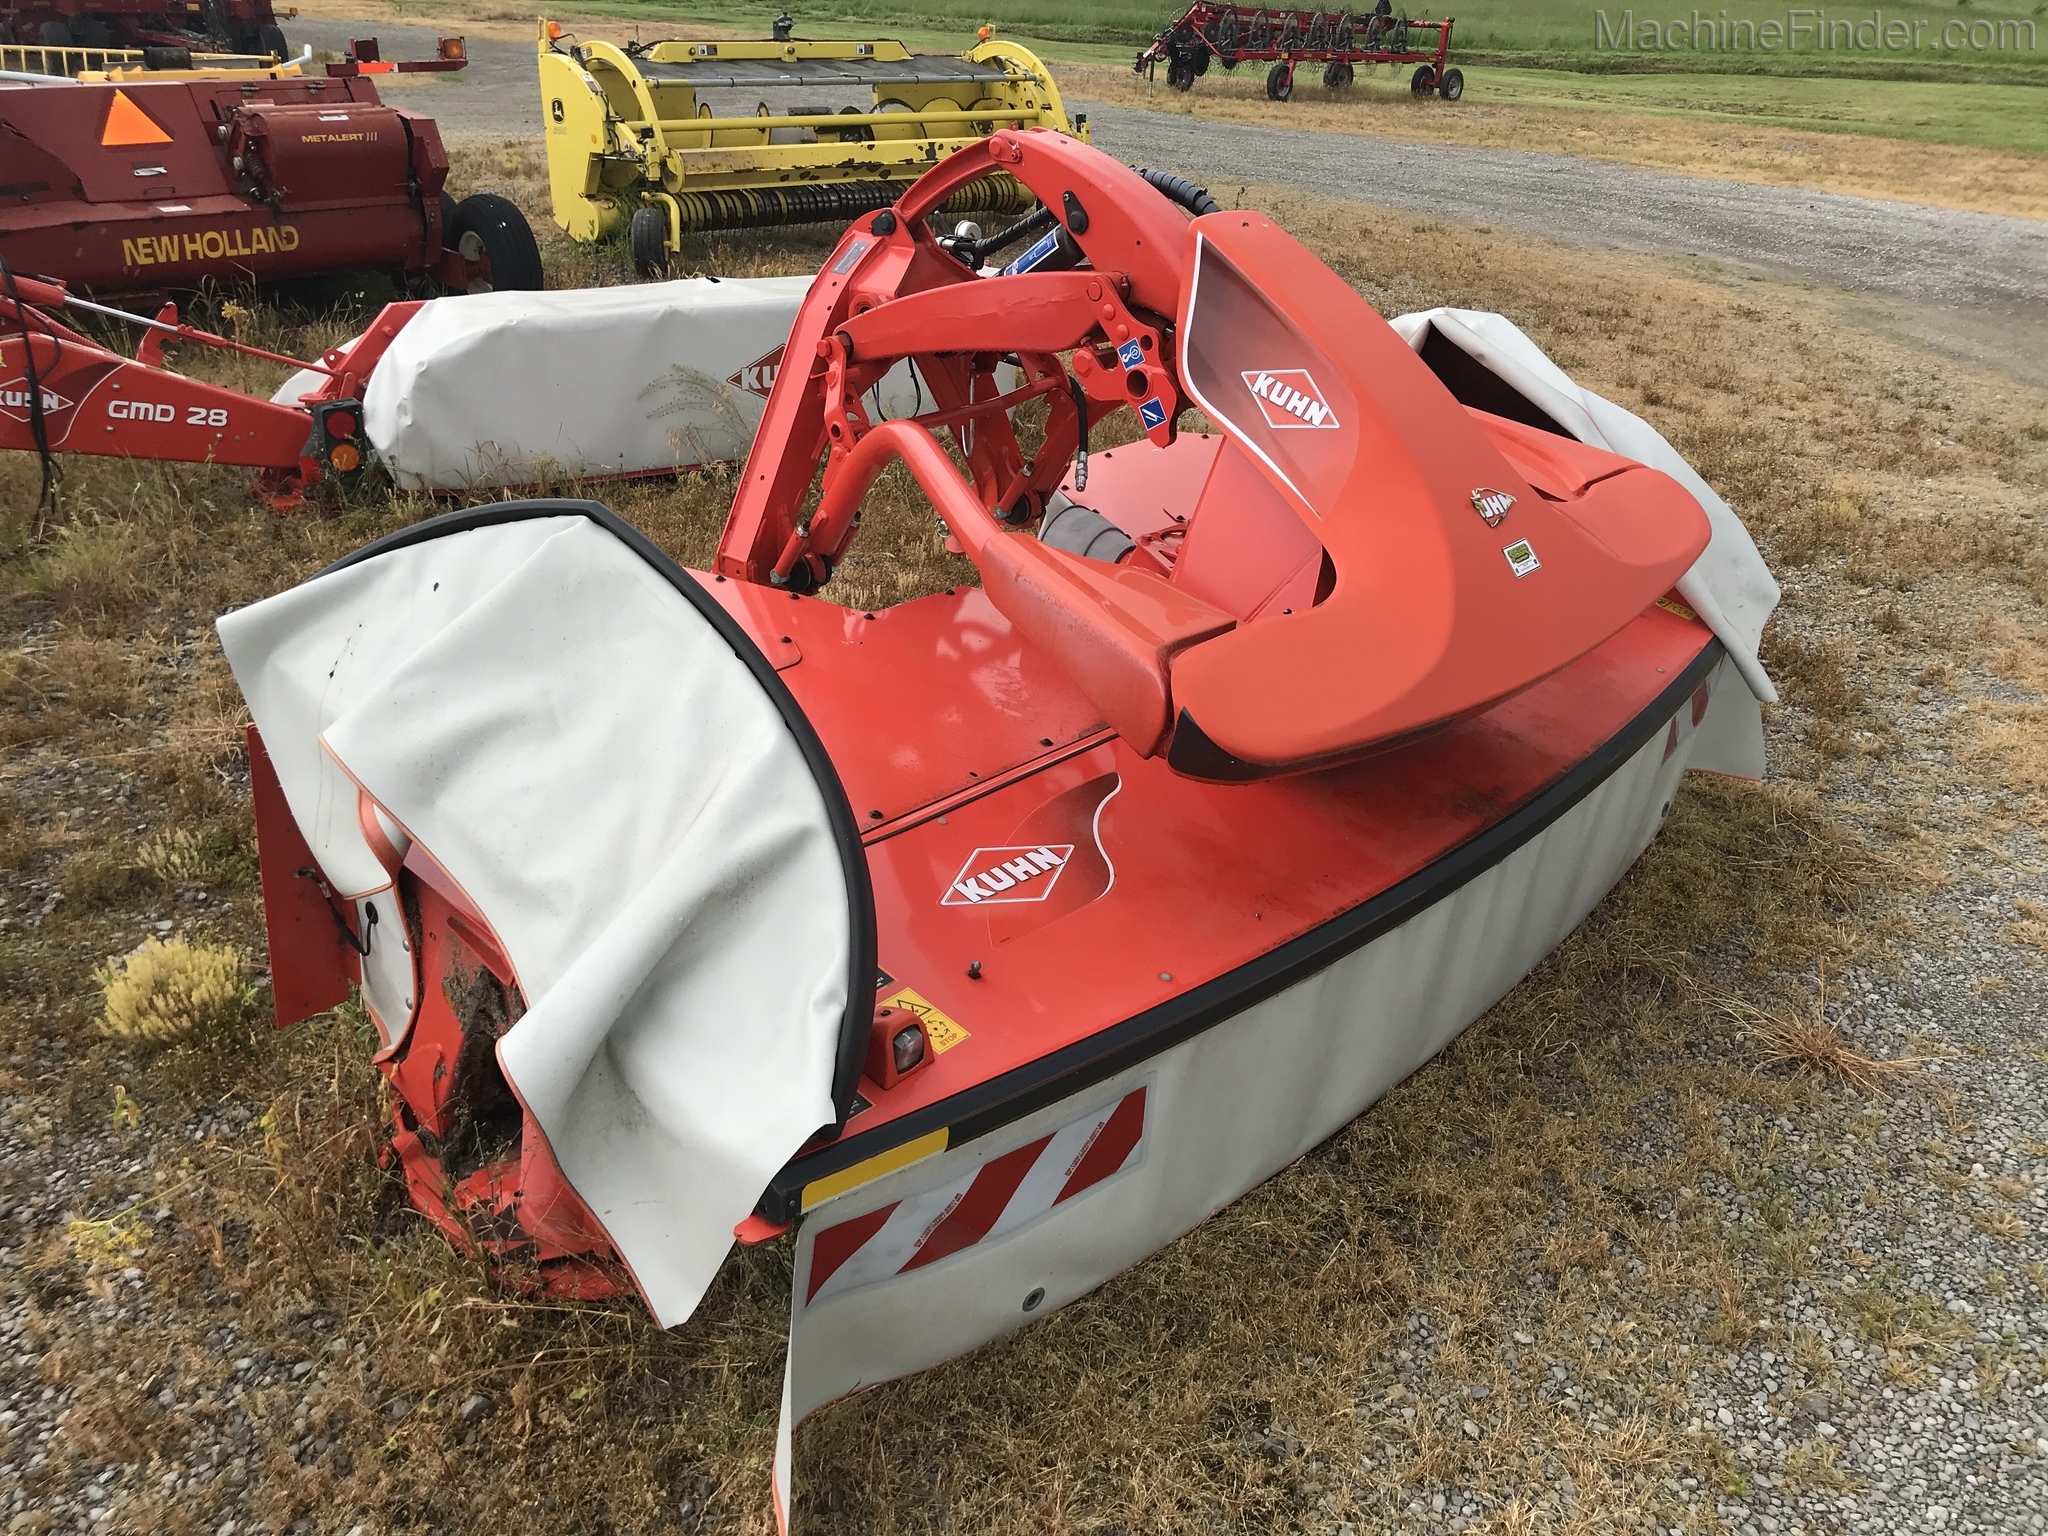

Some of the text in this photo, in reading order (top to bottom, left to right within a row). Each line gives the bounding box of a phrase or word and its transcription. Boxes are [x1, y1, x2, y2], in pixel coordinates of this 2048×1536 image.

[301, 133, 364, 143] METALERT
[122, 224, 300, 266] NEW HOLLAND
[107, 399, 229, 428] GMD 28
[1250, 371, 1330, 428] KUHN
[952, 845, 1066, 904] KUHN
[939, 1032, 959, 1047] STOP
